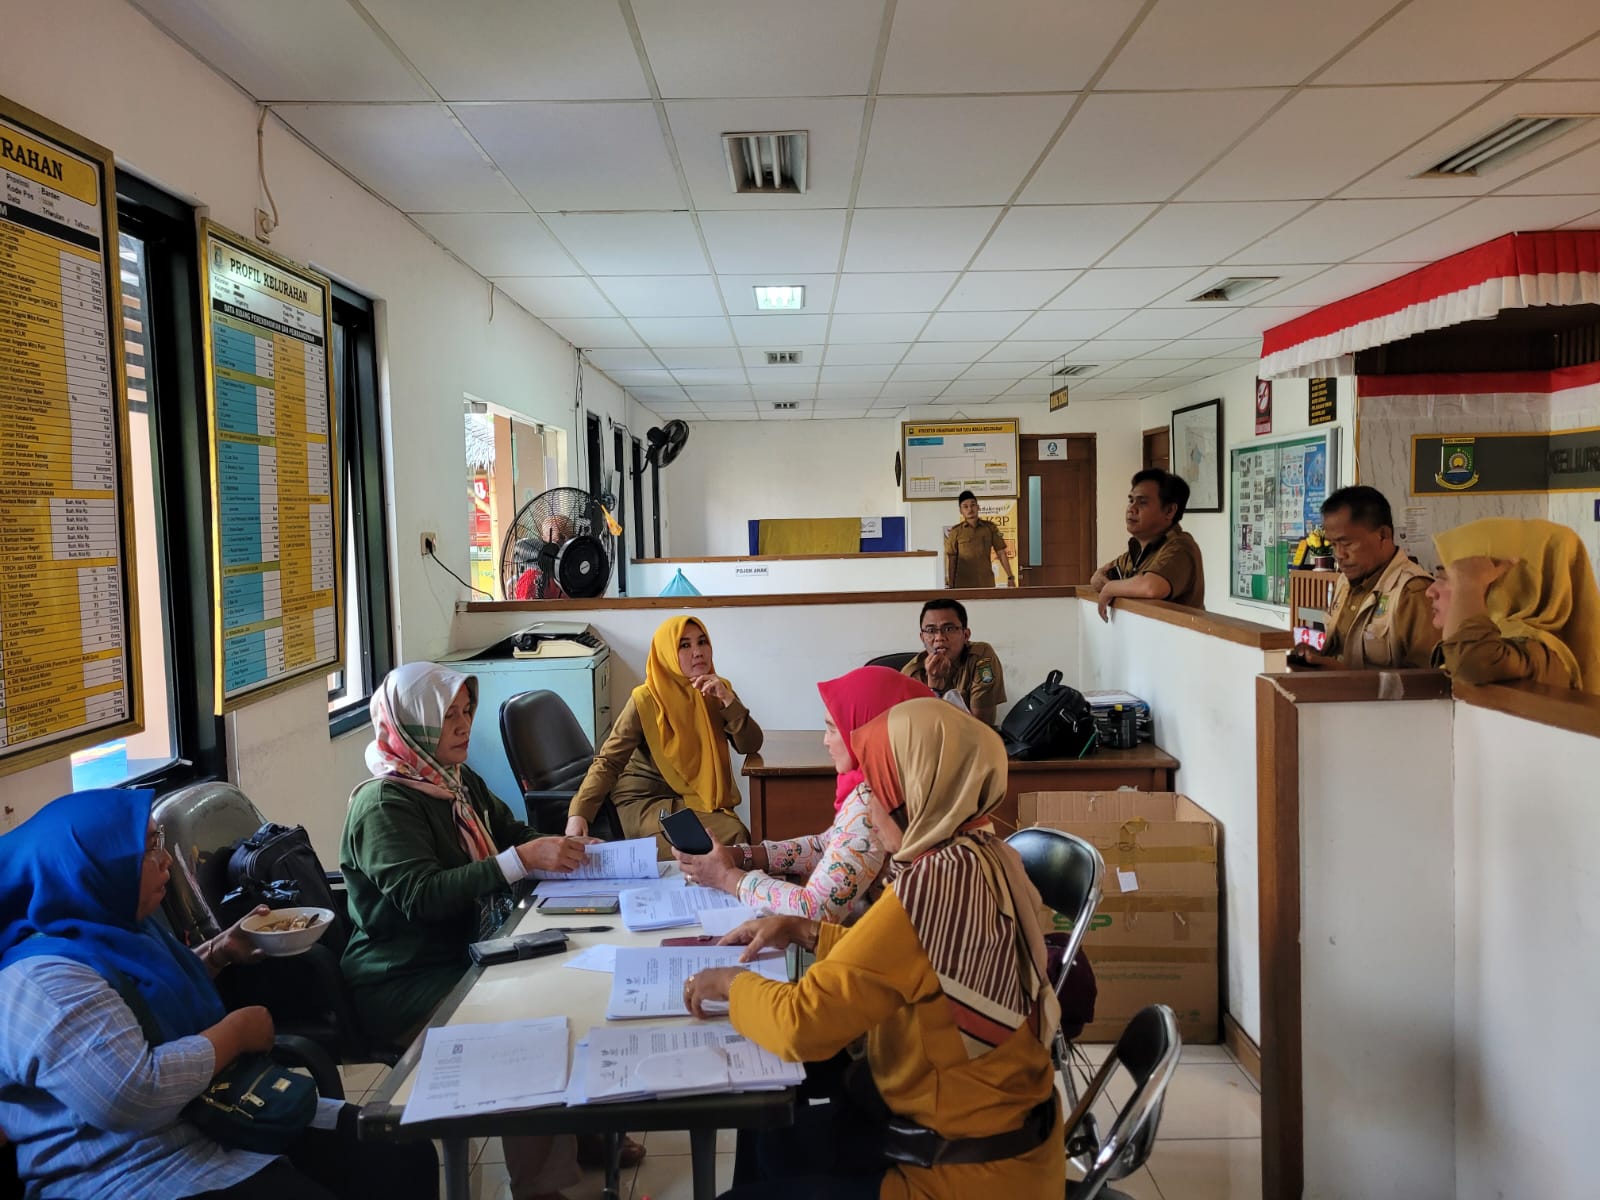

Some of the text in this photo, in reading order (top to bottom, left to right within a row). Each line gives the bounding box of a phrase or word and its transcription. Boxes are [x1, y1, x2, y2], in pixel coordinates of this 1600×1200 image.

[0, 137, 63, 182] RAHAN
[230, 257, 261, 284] PROFIL
[263, 272, 308, 305] KELURAHAN
[223, 303, 235, 316] DATA
[235, 306, 251, 321] BIDANG
